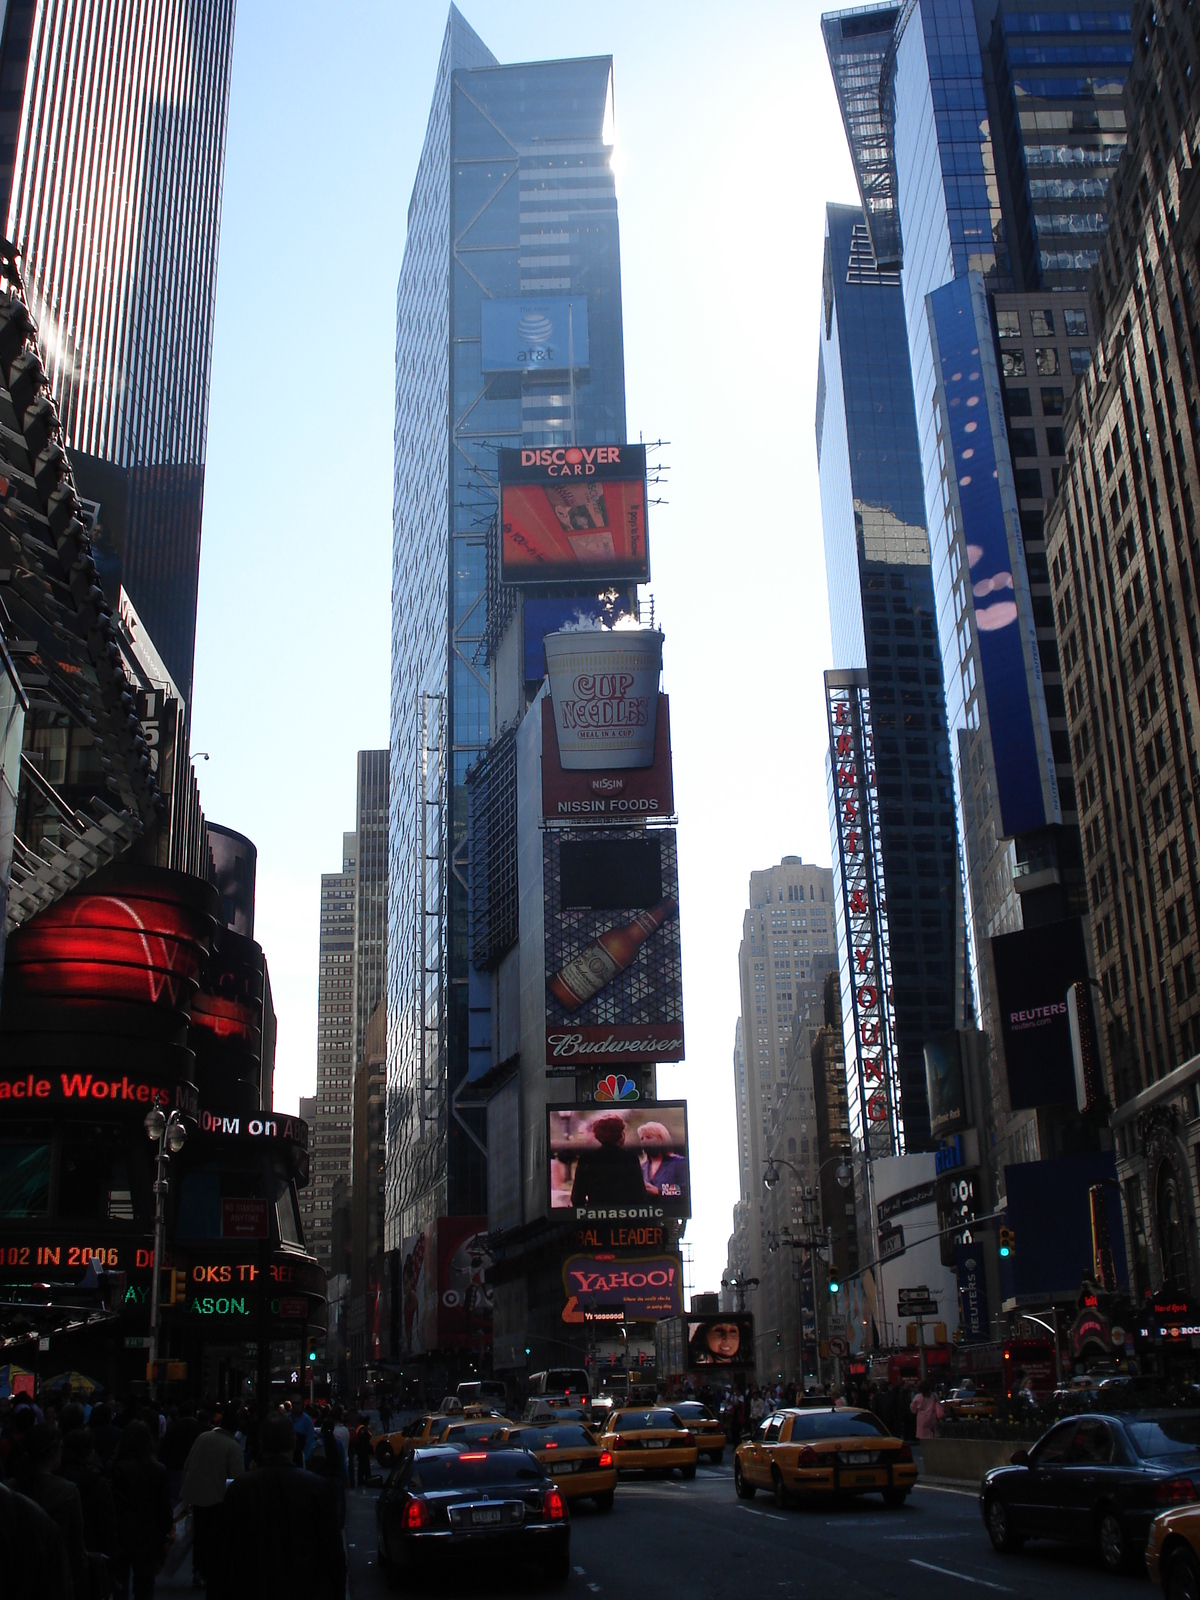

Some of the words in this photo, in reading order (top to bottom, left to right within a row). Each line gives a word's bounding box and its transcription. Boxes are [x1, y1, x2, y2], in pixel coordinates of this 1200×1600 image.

[517, 347, 554, 362] at&t
[521, 446, 621, 466] DISCOVER
[548, 464, 596, 476] CARD
[572, 672, 635, 700] CUP
[560, 697, 649, 729] NOODLES
[602, 730, 609, 738] IN
[618, 729, 633, 737] CUP
[592, 778, 623, 790] NISSIN
[835, 703, 860, 853] ERNST
[558, 800, 605, 813] NISSIN
[610, 799, 659, 811] FOODS
[850, 890, 867, 913] &
[1010, 1002, 1067, 1023] REUTERS
[1011, 1018, 1052, 1030] reuters.com
[856, 949, 886, 1121] YOUNG
[547, 1033, 683, 1057] Budweiser
[60, 1073, 169, 1105] Workers
[247, 1119, 278, 1137] on
[237, 1204, 265, 1213] STANDING
[576, 1206, 664, 1219] Panasonic
[230, 1214, 260, 1223] ANYTIME
[611, 1228, 663, 1246] LEADER
[36, 1246, 61, 1266] IN
[67, 1246, 119, 1267] 2006
[570, 1268, 675, 1292] YAHOO!
[967, 1273, 980, 1334] REUTERS
[1154, 1304, 1171, 1312] Hard
[1171, 1304, 1187, 1314] Rock
